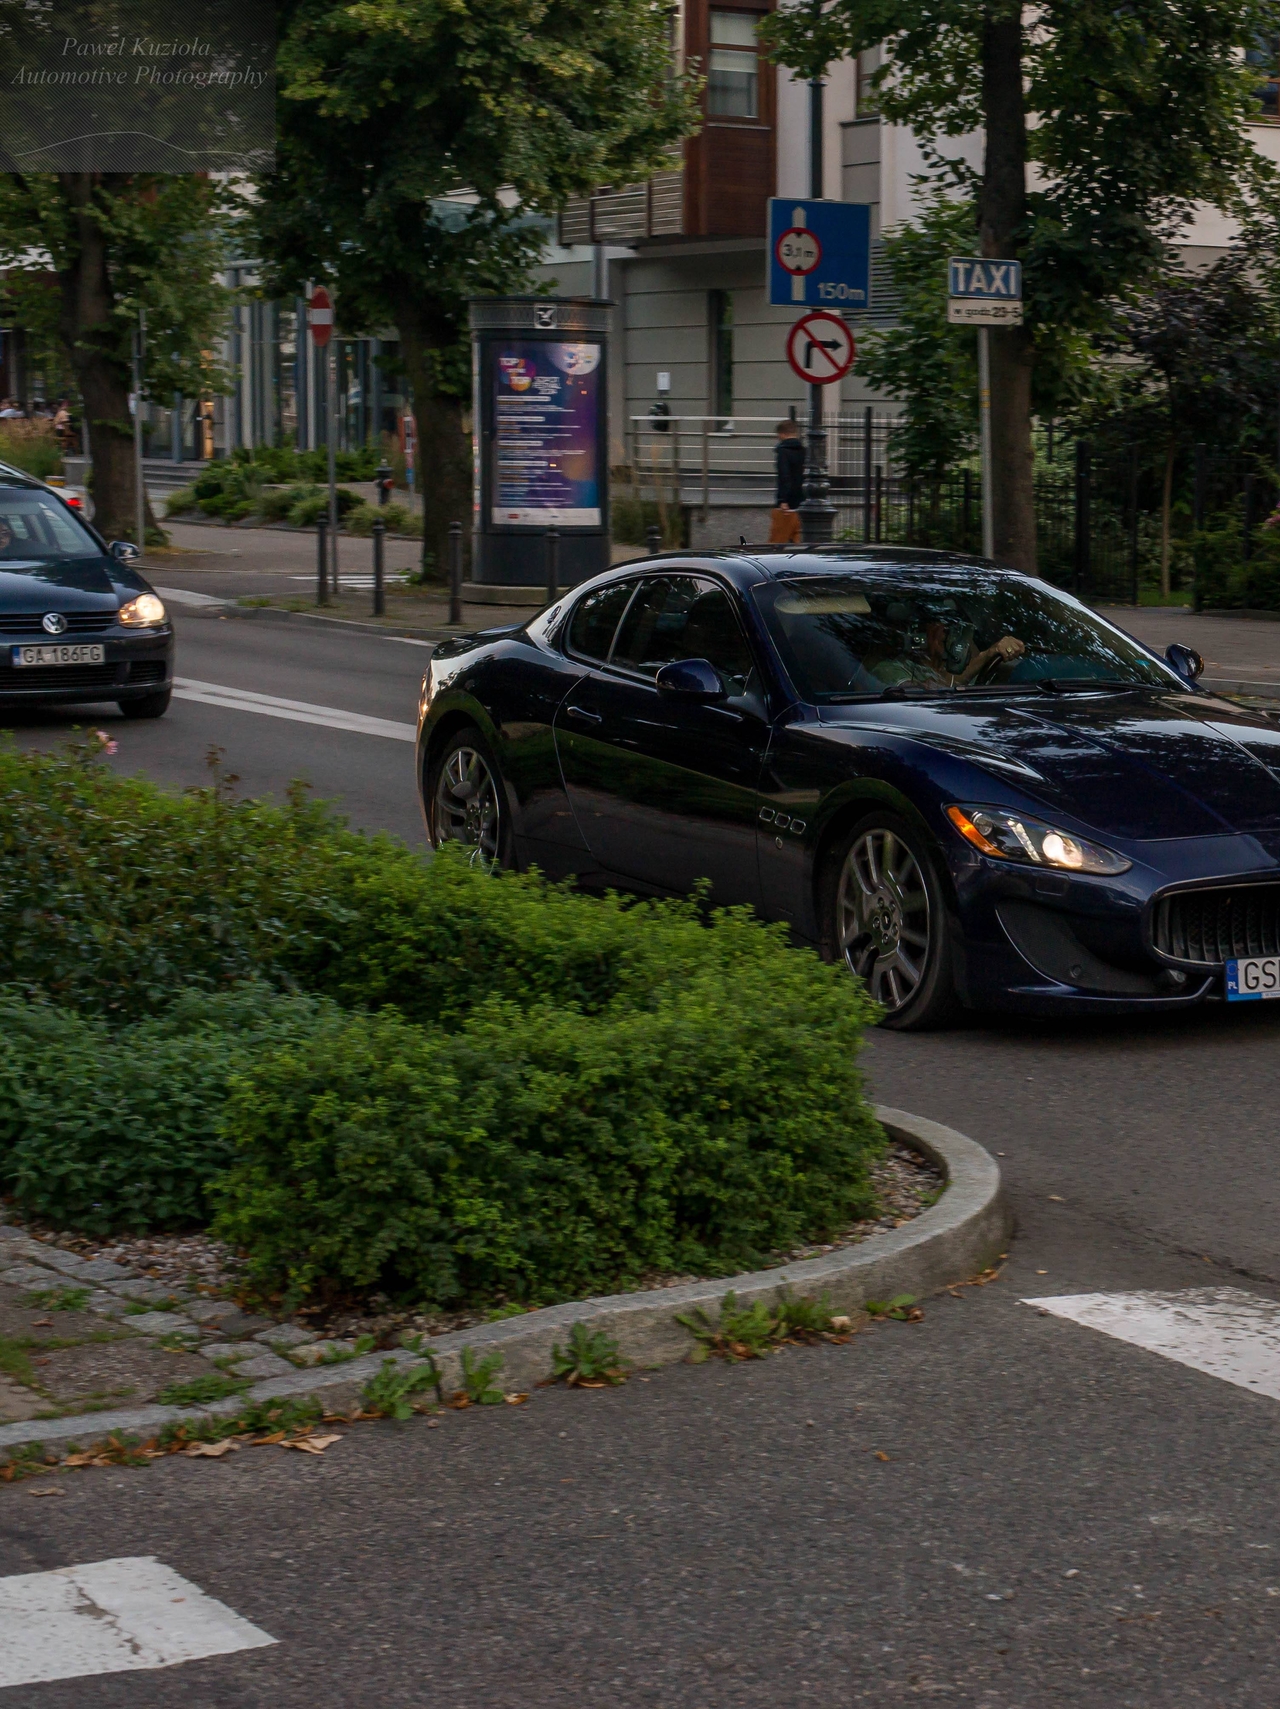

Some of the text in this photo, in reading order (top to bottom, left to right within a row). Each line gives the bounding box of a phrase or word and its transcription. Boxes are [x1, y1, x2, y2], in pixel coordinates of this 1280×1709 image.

[952, 262, 1017, 295] TAXI
[23, 646, 101, 663] GA 186FG
[1228, 981, 1238, 990] PL
